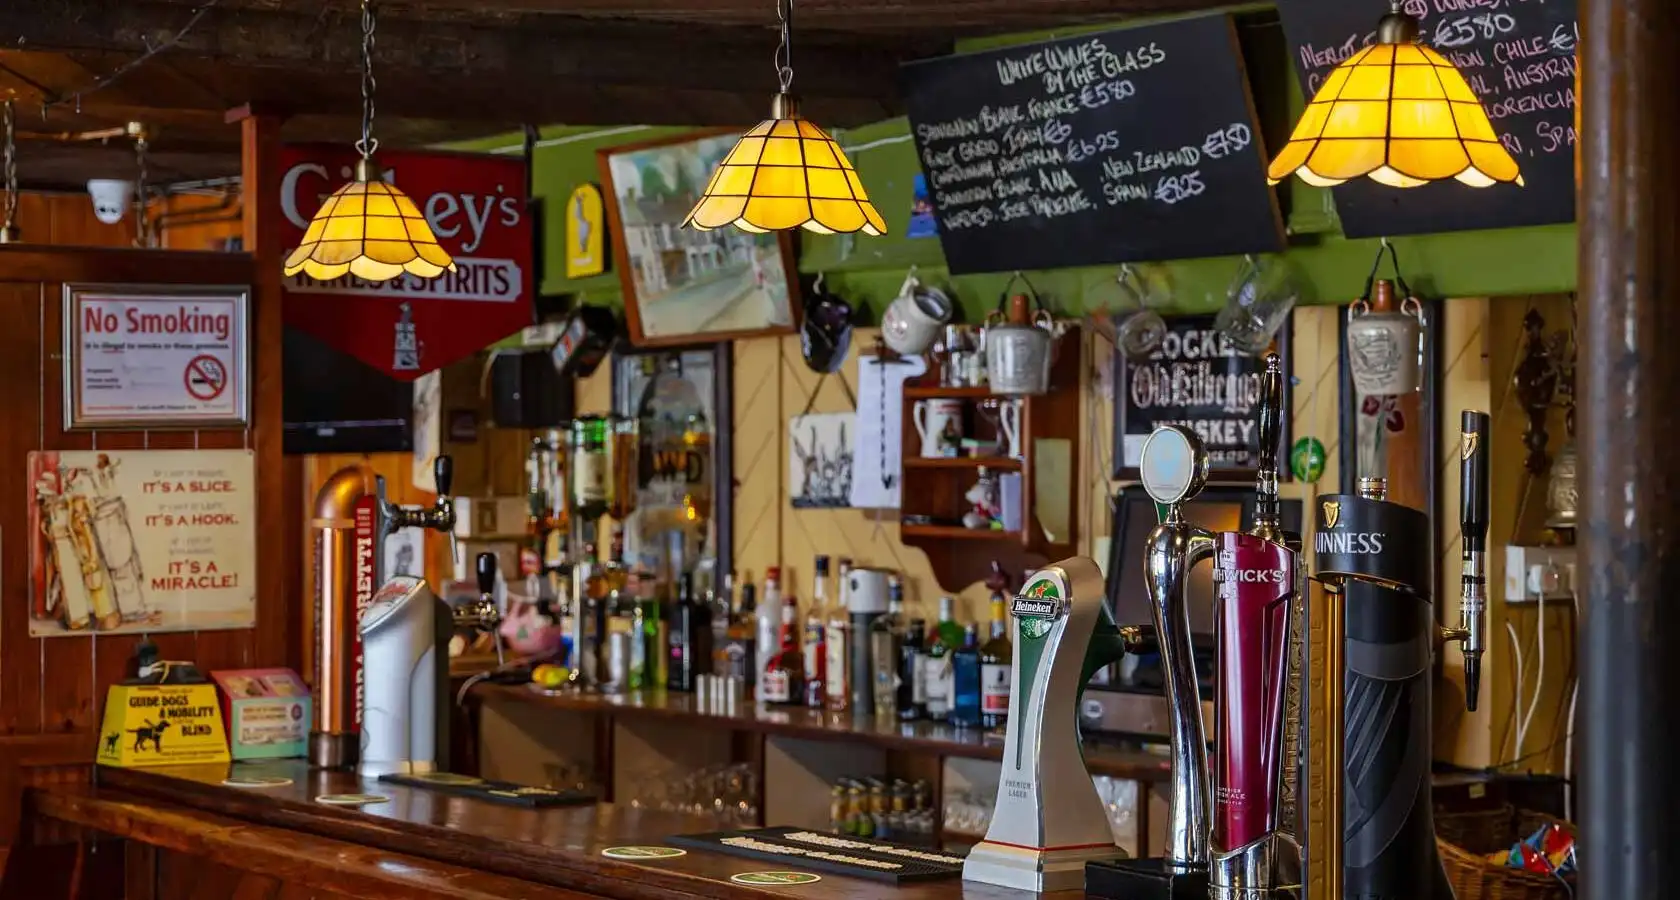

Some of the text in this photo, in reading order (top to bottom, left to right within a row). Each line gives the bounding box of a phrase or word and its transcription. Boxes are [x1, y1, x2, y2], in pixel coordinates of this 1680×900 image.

[1494, 36, 1548, 64] CHILE
[997, 53, 1046, 85] WHITE
[1066, 64, 1100, 88] THE
[1101, 42, 1166, 78] GLASS
[1503, 56, 1579, 91] AUSTRA
[1484, 88, 1576, 119] LORENCIA
[1536, 121, 1579, 152] SPA
[1133, 146, 1200, 172] ZEALAND
[1103, 182, 1149, 205] SPAIN
[85, 306, 230, 341] No Smoking
[1172, 361, 1261, 414] Kilbegga
[1152, 419, 1255, 444] SKEY
[143, 480, 237, 494] IT'S A SLICE.
[145, 513, 240, 527] IT'S A HOOK.
[1315, 532, 1384, 554] UINNESS
[168, 558, 218, 575] IT'S A
[151, 572, 239, 591] MIRACLE!
[355, 537, 372, 643] RETTI
[1015, 600, 1051, 613] Heineken
[161, 695, 189, 707] DOGS
[181, 723, 212, 737] BLIND
[1008, 789, 1027, 798] LAGER
